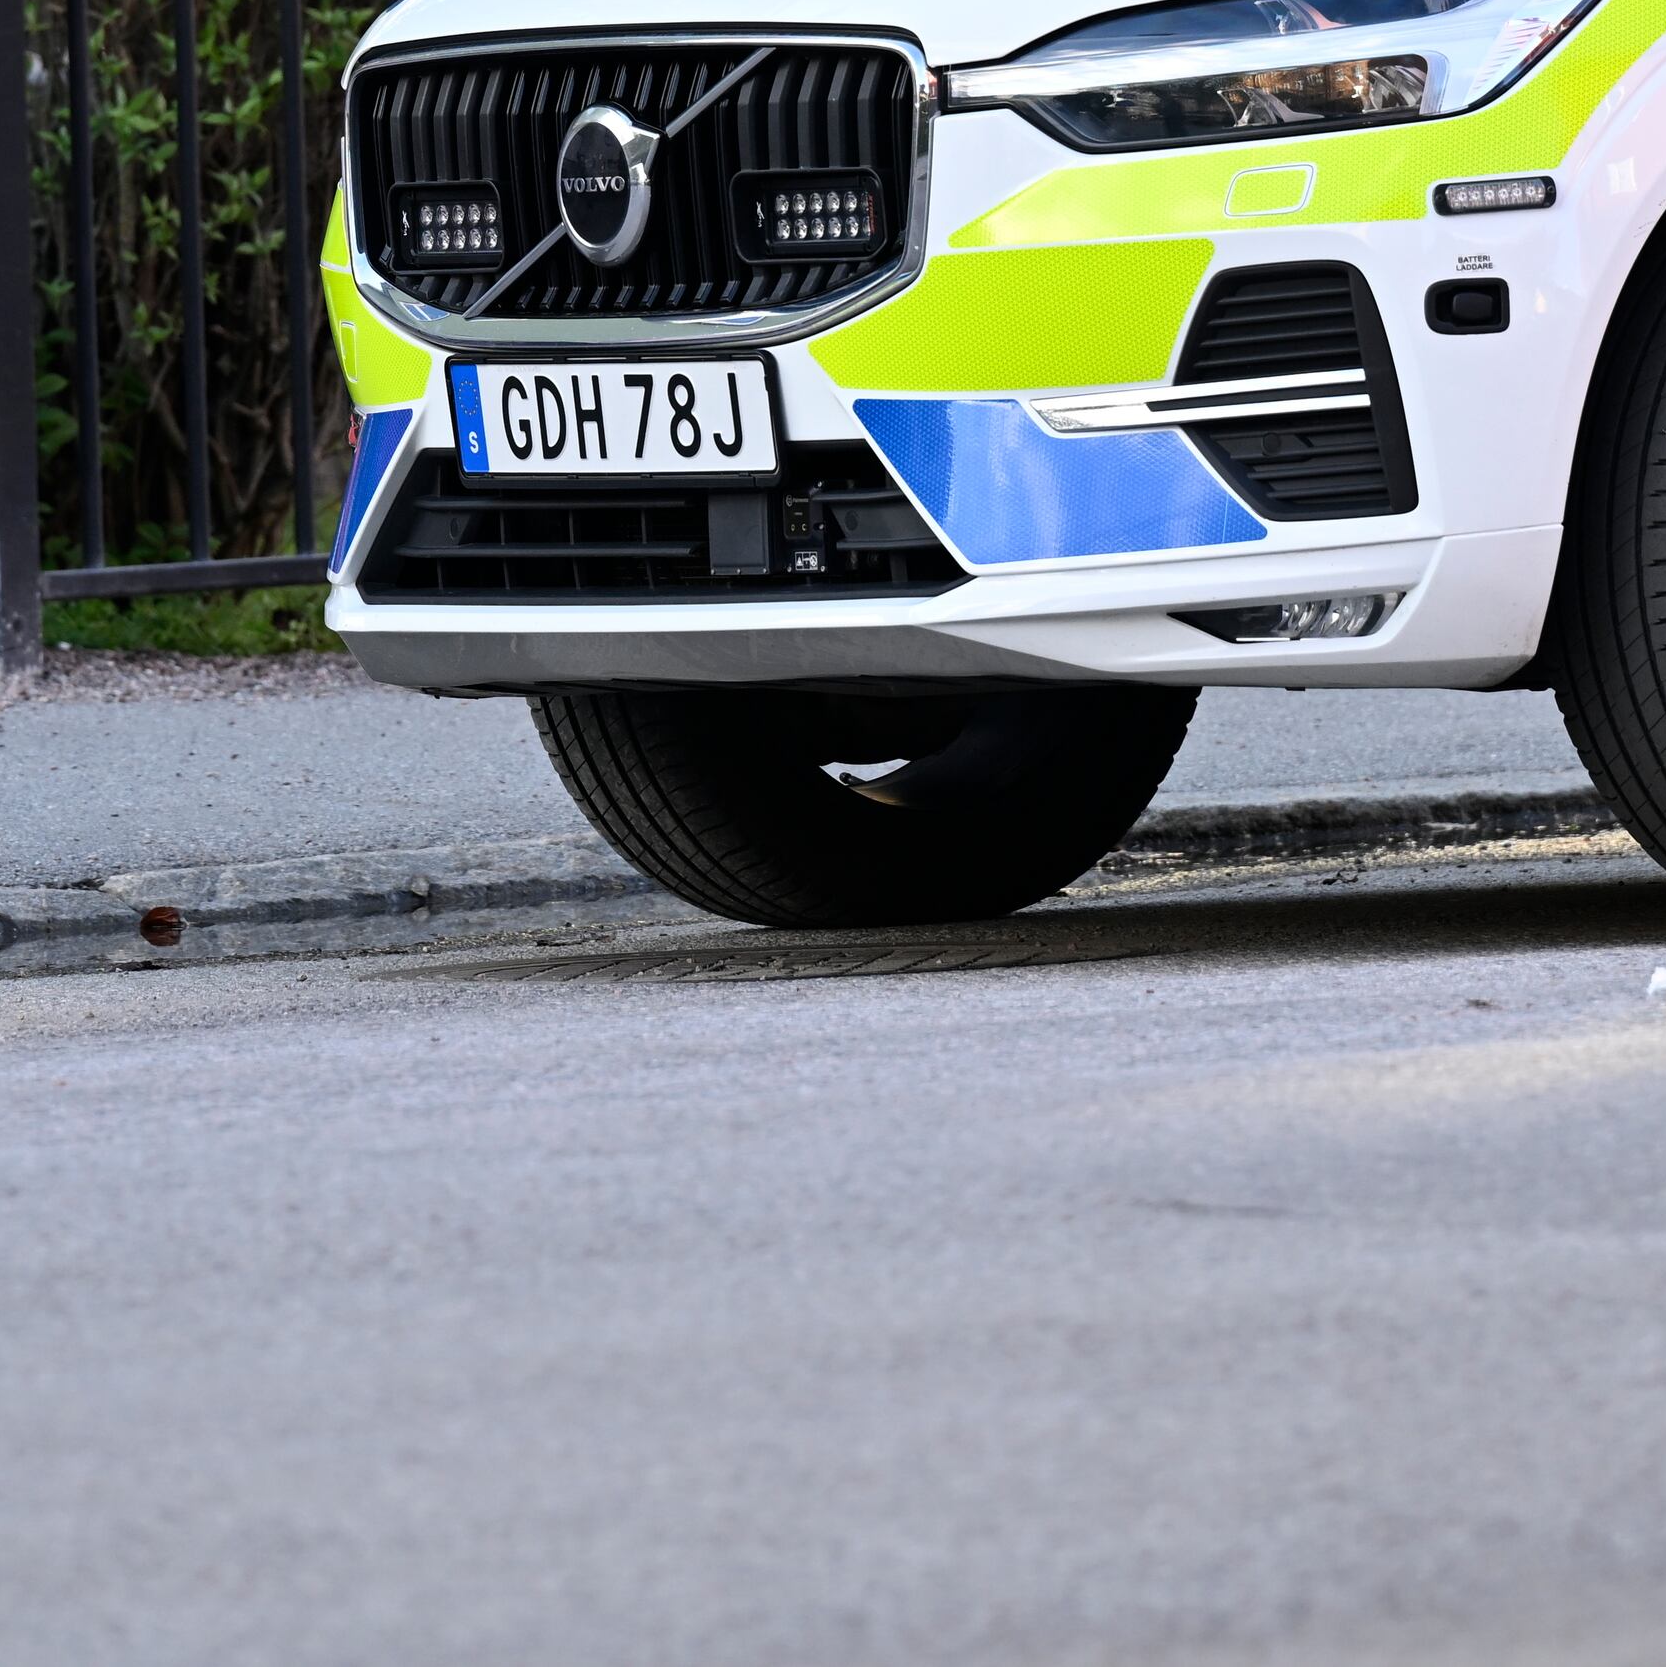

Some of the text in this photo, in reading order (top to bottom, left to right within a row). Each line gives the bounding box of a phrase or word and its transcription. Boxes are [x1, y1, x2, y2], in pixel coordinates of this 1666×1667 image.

[562, 175, 625, 194] VOLVO
[1456, 263, 1494, 271] LADDARE
[1458, 255, 1491, 263] BATTERI
[501, 371, 744, 460] GDH 78J
[468, 431, 479, 454] S
